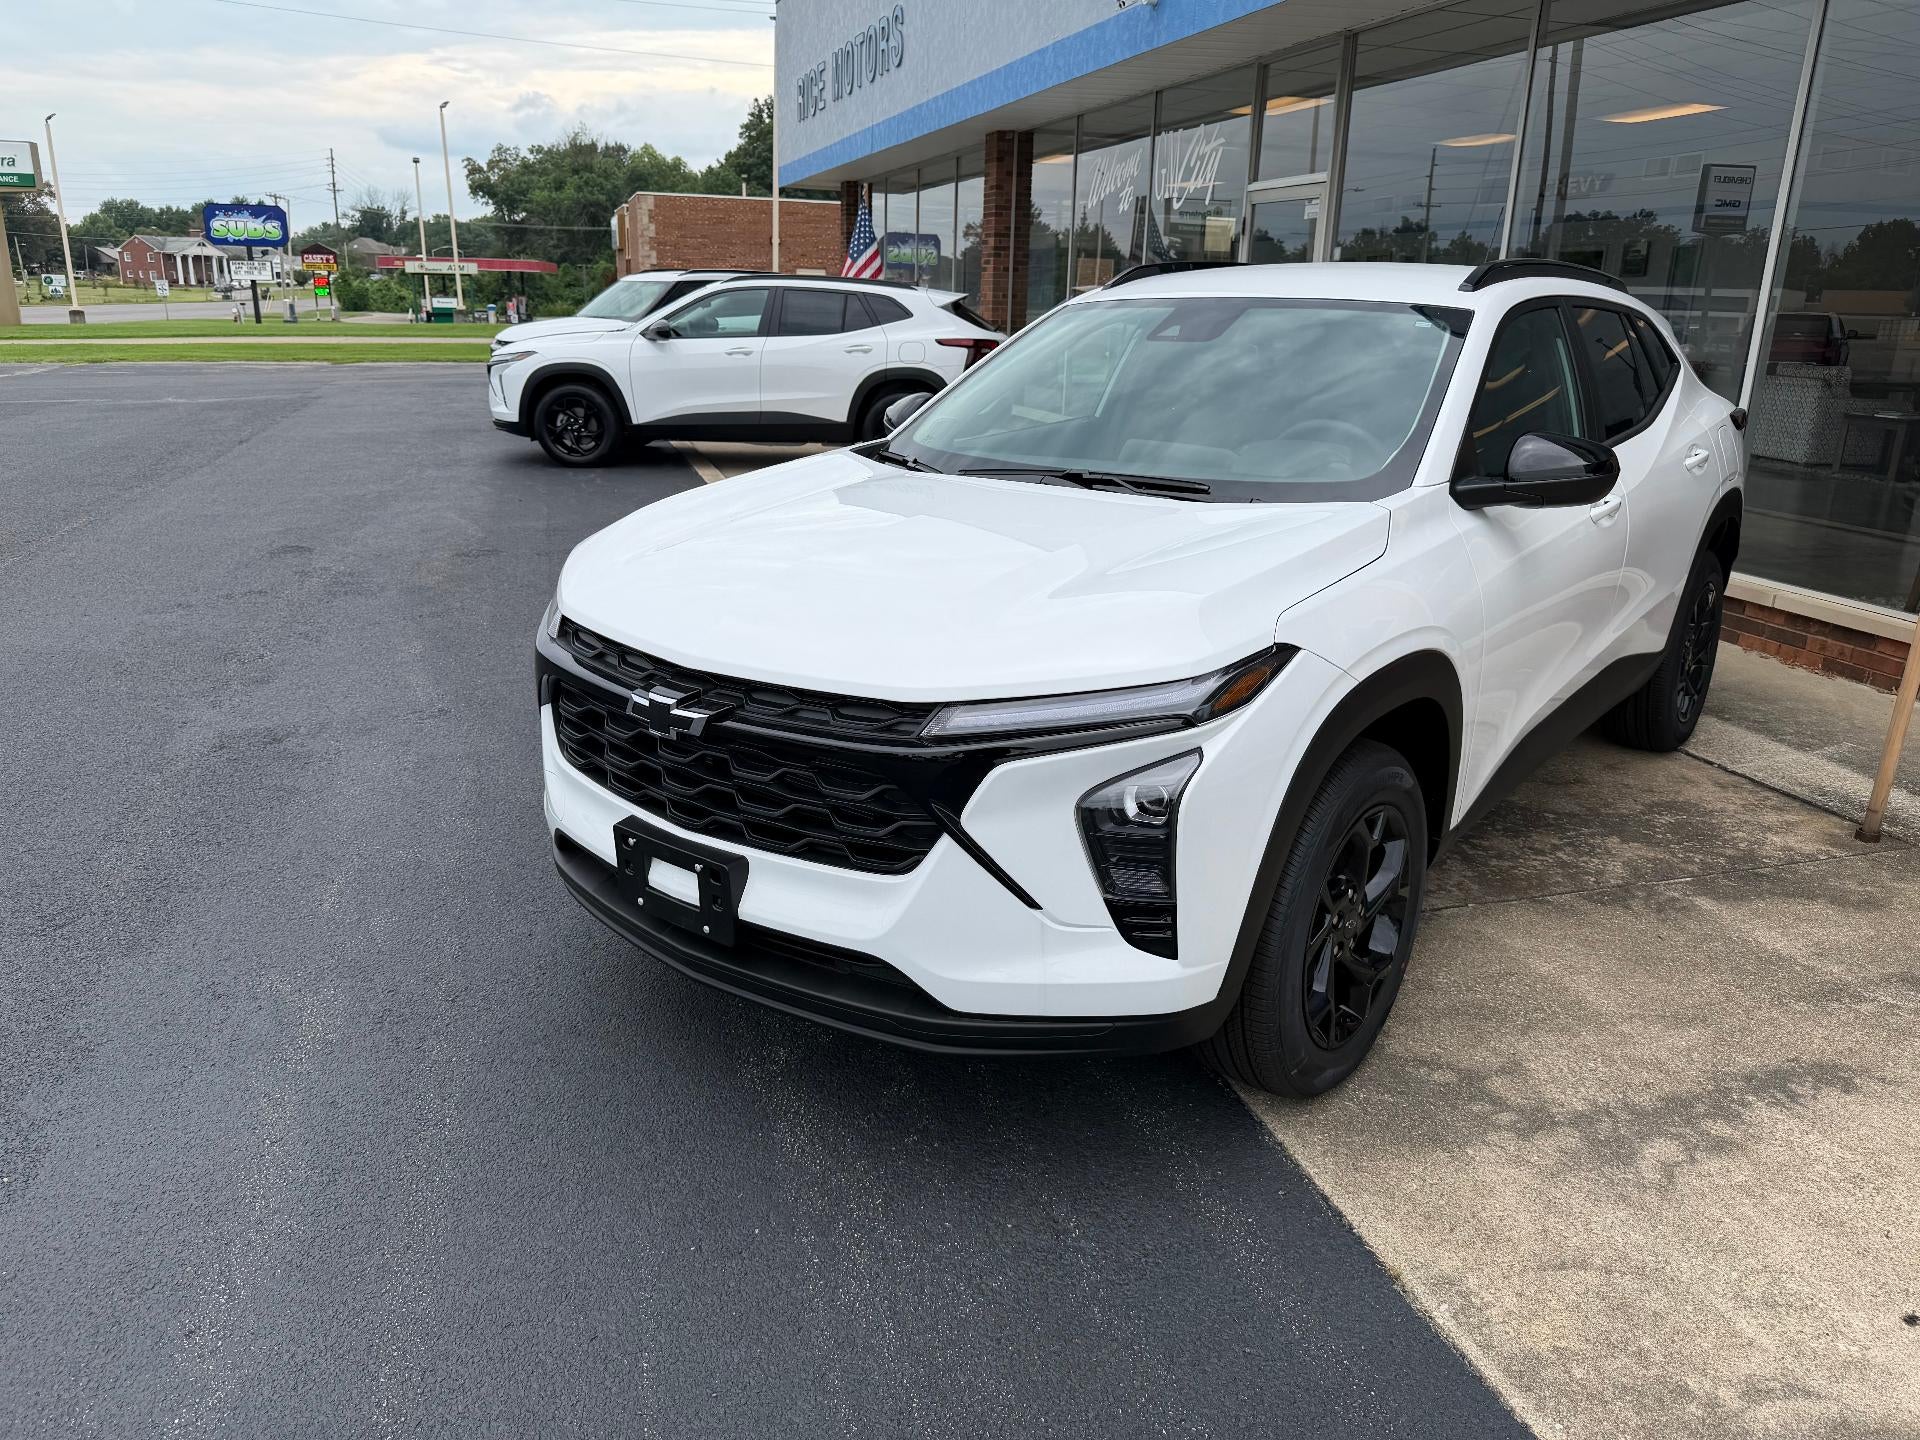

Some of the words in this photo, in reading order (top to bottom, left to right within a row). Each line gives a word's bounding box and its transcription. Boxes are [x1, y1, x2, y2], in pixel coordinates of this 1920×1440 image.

[797, 60, 826, 123] RICE
[831, 3, 905, 102] MOTORS
[210, 218, 282, 240] SUDS
[303, 254, 335, 264] CASEY'S
